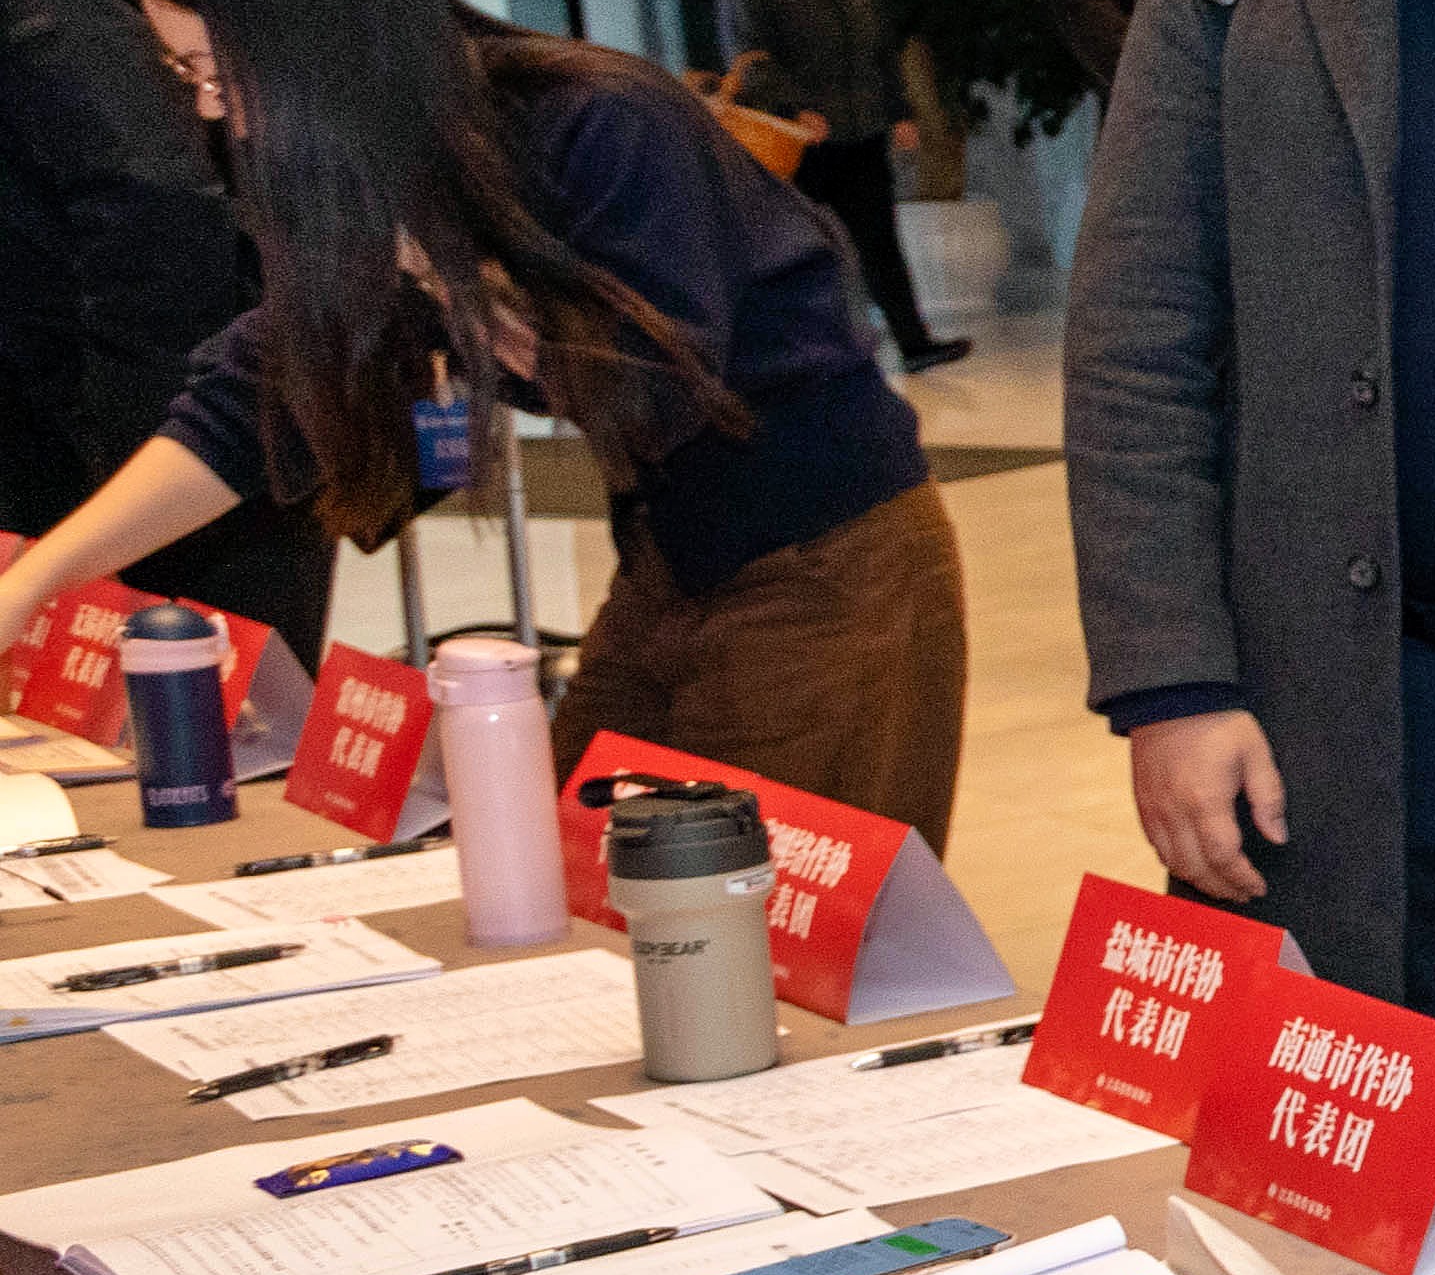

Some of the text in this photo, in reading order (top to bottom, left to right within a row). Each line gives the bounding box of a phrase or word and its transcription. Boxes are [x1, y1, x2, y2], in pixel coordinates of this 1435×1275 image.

[1101, 921, 1223, 1003] 盐城市作协
[1101, 987, 1191, 1060] 代表团
[1269, 1017, 1413, 1111] 南通市作协
[1269, 1088, 1374, 1172] 代表团
